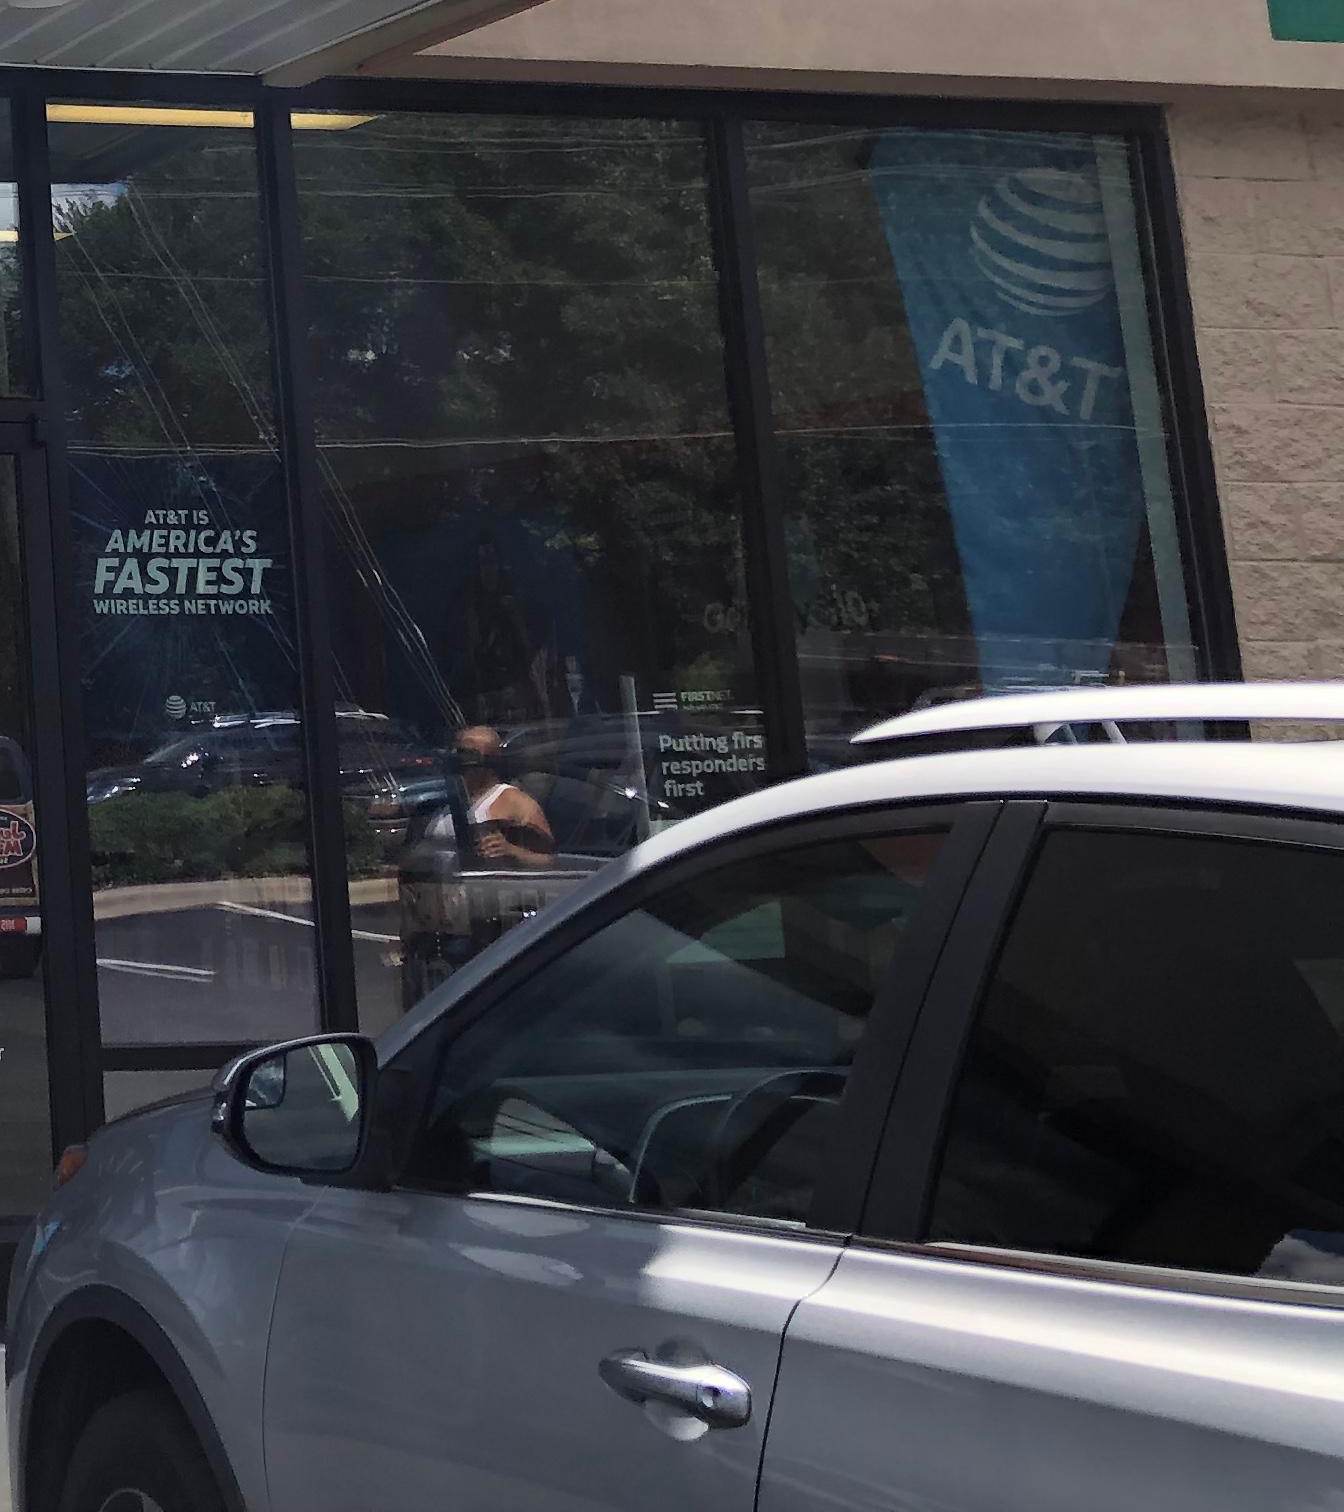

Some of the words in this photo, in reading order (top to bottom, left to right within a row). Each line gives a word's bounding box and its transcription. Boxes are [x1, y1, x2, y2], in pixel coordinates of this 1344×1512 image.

[929, 316, 1122, 421] AT&T
[144, 509, 189, 525] AT&T
[193, 509, 209, 525] IS
[105, 529, 257, 554] AMERICA'S
[93, 557, 273, 595] FASTEST
[93, 598, 180, 615] WIRELESS
[184, 598, 273, 615] NETWORK
[190, 700, 216, 713] AT&T
[659, 733, 729, 754] Putting
[732, 731, 764, 750] firs
[662, 755, 766, 777] responders
[664, 779, 704, 798] first
